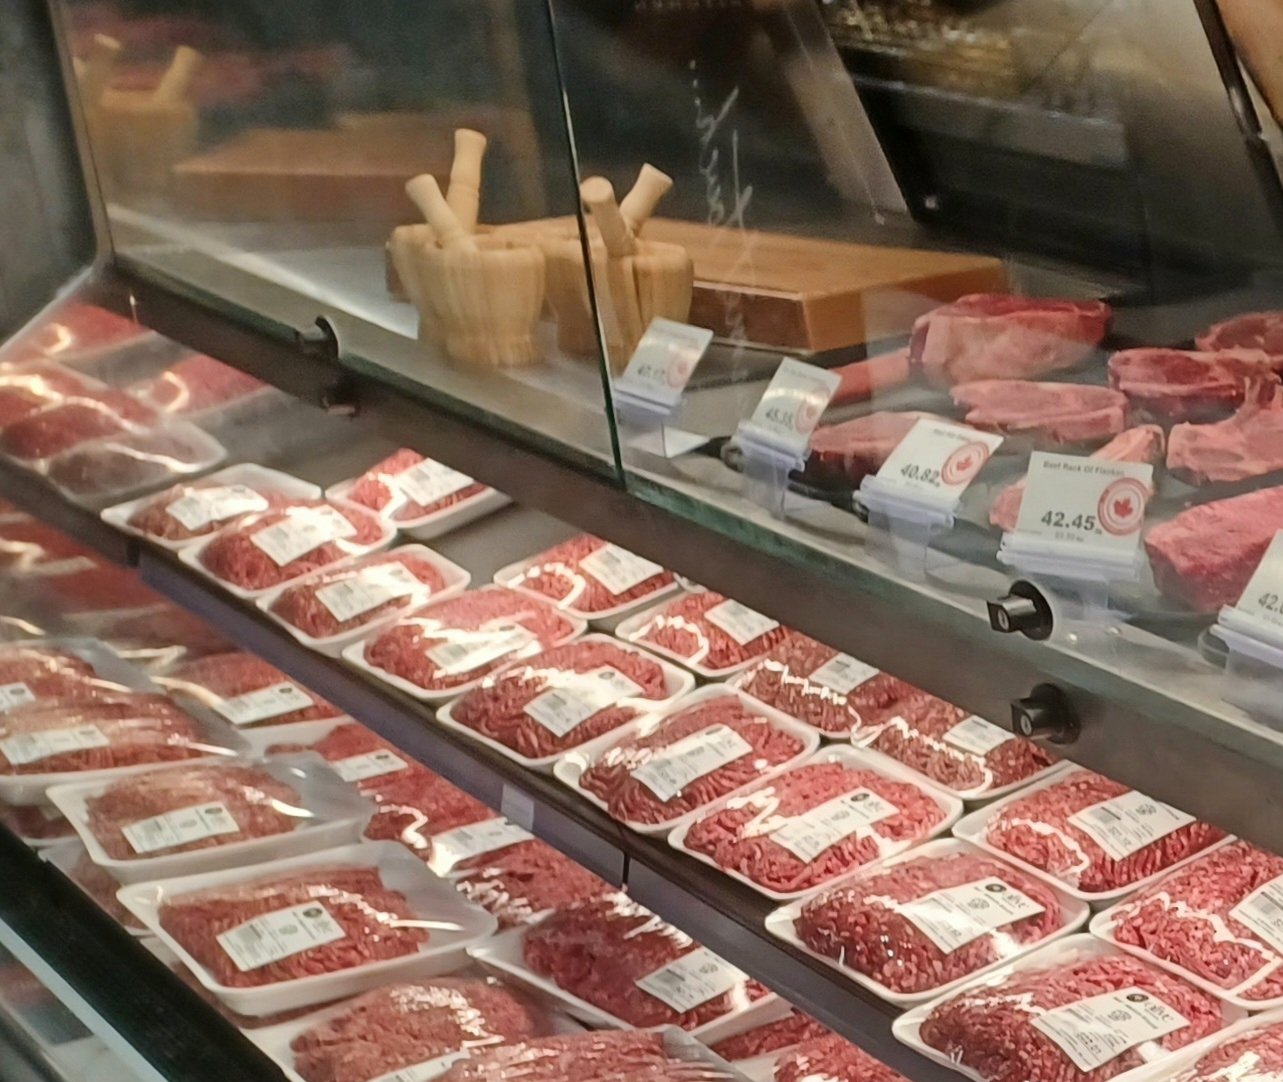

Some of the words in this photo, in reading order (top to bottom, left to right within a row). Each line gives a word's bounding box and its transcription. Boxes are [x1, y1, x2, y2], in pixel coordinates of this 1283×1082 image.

[901, 463, 939, 484] 40.82
[1063, 463, 1081, 472] Rack
[1040, 510, 1096, 531] 42.45
